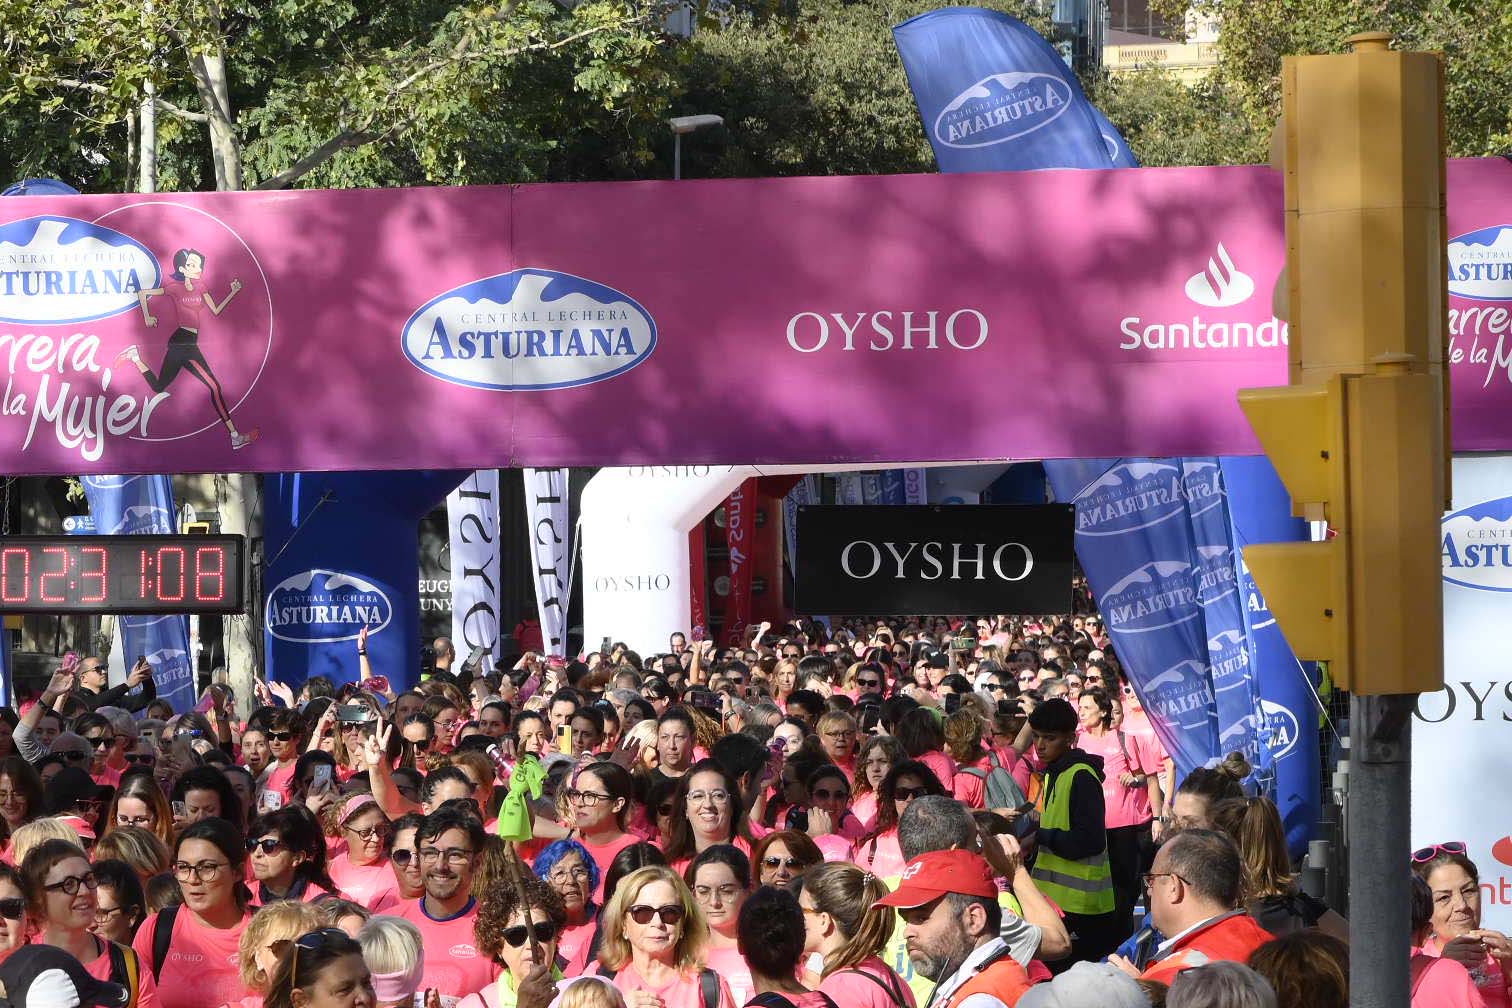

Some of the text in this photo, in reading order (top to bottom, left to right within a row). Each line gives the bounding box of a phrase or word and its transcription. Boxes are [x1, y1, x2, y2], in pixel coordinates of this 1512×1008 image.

[1448, 257, 1512, 282] STUR
[461, 309, 629, 324] CENTRAL LECHERA
[421, 316, 637, 360] ASTURIANA
[786, 308, 988, 353] OYSHO
[1469, 336, 1488, 364] la
[1, 376, 27, 416] la
[22, 367, 171, 462] Mujer
[1467, 529, 1512, 539] CENT
[841, 540, 1034, 581] OYSHO
[595, 574, 671, 593] OYSHO
[329, 594, 377, 603] LECHERA
[270, 600, 382, 627] ASTURIANA
